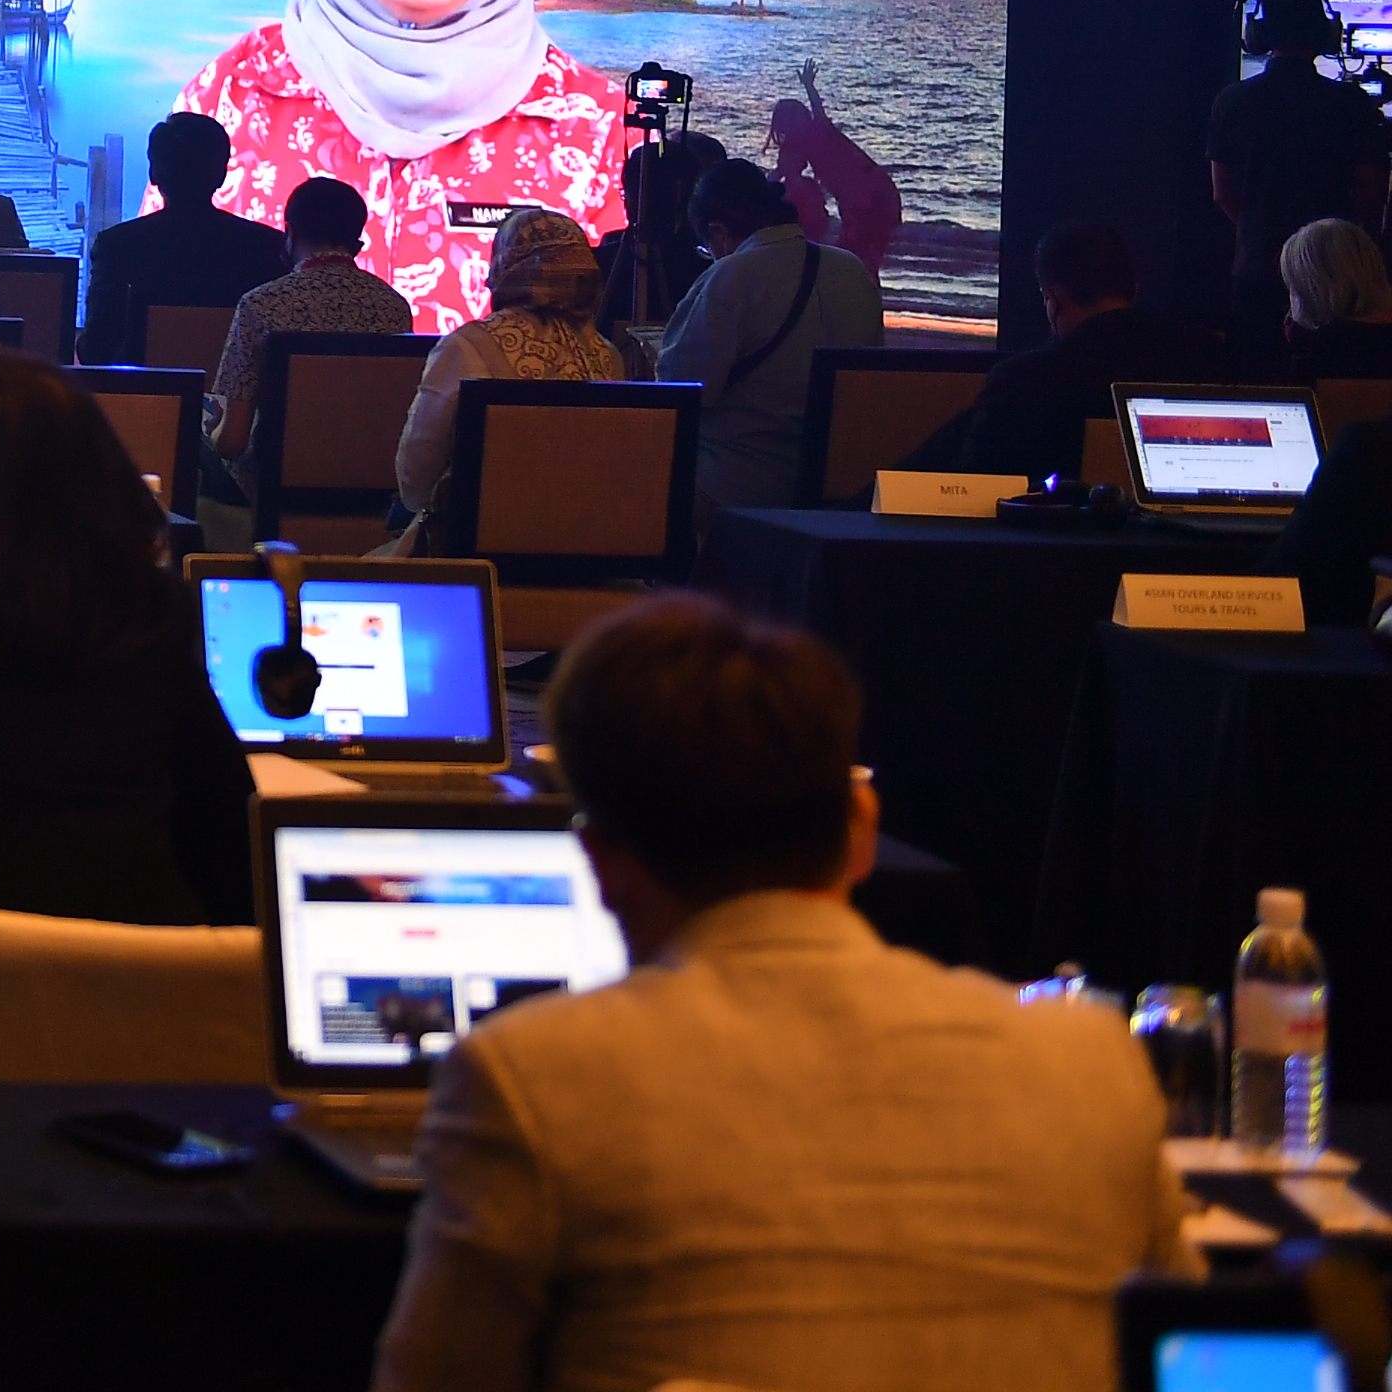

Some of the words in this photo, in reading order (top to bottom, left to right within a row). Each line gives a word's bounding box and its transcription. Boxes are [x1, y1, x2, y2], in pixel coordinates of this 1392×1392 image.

[940, 485, 968, 495] MITA
[1177, 589, 1234, 600] OVERLAND
[1236, 590, 1283, 601] SERVICES
[1172, 604, 1207, 615] TOURS
[1221, 604, 1258, 616] TRAVEL
